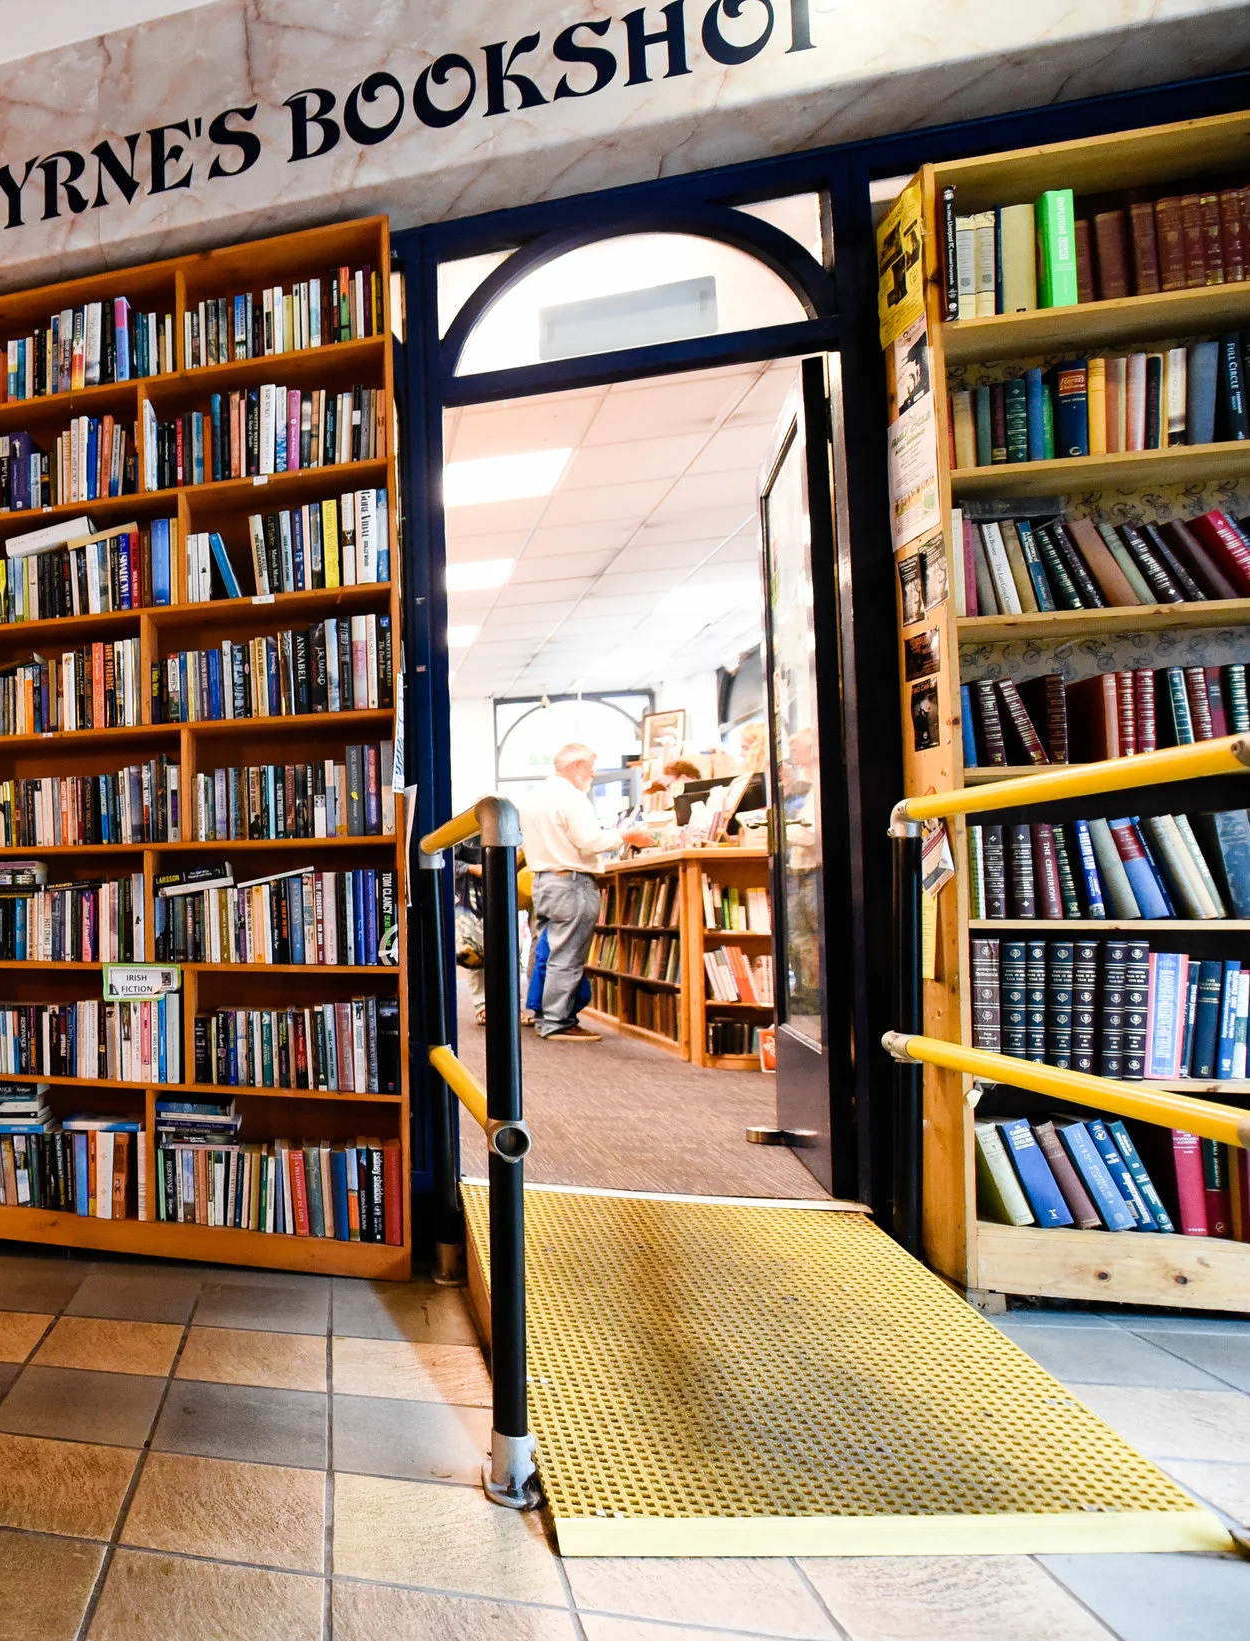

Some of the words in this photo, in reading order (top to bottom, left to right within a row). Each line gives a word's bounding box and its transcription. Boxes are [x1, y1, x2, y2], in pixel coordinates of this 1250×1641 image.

[1227, 343, 1235, 361] FULL
[1229, 362, 1238, 389] CIRCLE
[360, 491, 371, 514] GORE
[361, 515, 371, 538] VIDAL
[986, 525, 994, 539] Brock
[989, 539, 997, 556] Brower
[105, 644, 113, 660] DARK
[297, 636, 306, 682] ANNABEL
[105, 661, 114, 691] PARADISE
[1043, 842, 1052, 855] THE
[156, 872, 180, 882] LARSSON
[382, 873, 392, 887] TOM
[1045, 859, 1056, 902] CENTURIONS
[383, 888, 392, 914] CLANCY
[121, 985, 153, 993] FICTION
[372, 1152, 382, 1174] sidney
[374, 1176, 383, 1204] sheldon
